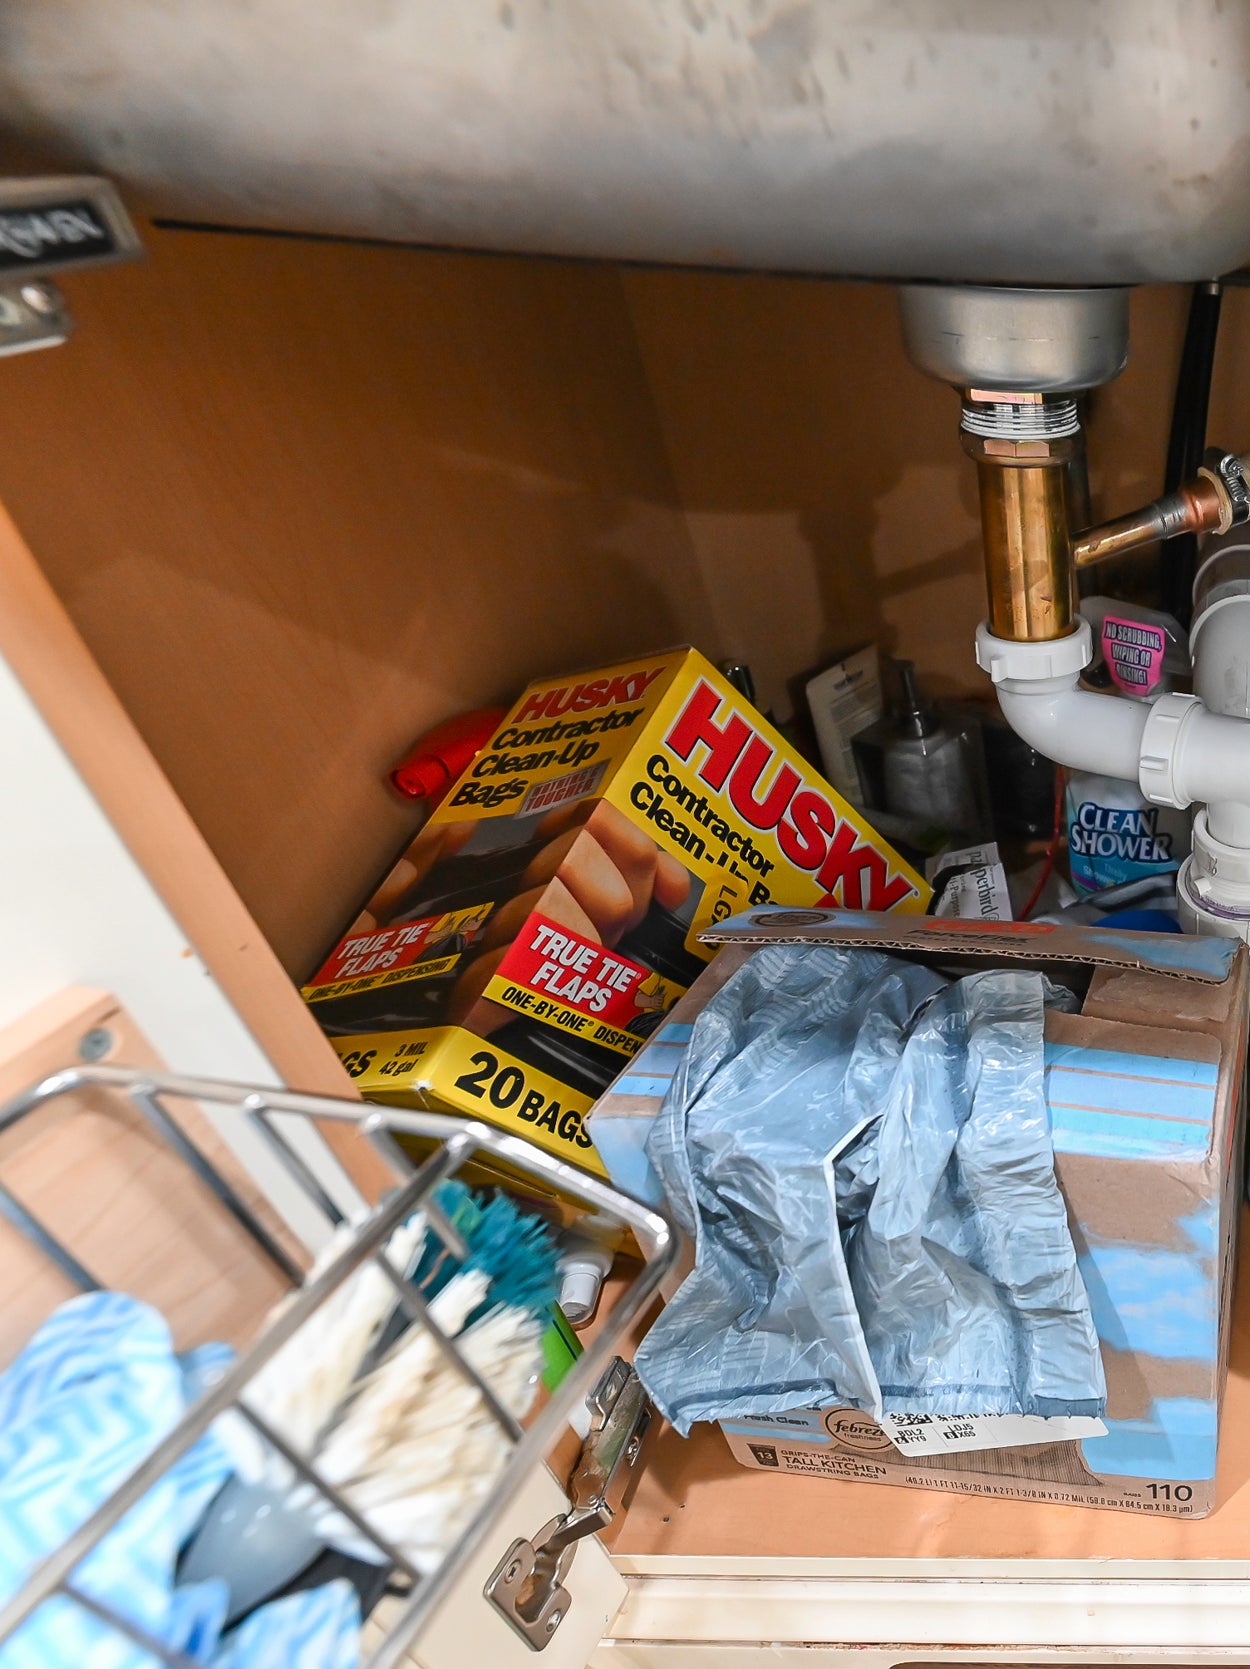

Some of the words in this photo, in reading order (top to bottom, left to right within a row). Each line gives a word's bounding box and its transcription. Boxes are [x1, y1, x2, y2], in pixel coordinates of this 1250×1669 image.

[1105, 622, 1118, 639] NO
[1117, 624, 1162, 652] SCRUBBING,
[1112, 643, 1140, 665] WIPING
[510, 666, 667, 725] HUSKY
[492, 708, 645, 750] Contractor
[472, 739, 600, 777] Clean-Up
[448, 778, 529, 808] Bags
[664, 679, 914, 911] HUSKY
[646, 754, 774, 878] Contractor
[1079, 804, 1158, 836] CLEAN
[1071, 825, 1171, 861] SHOWER
[337, 930, 395, 959] TRUE
[394, 922, 430, 946] TIE
[335, 947, 403, 979] FLAPS
[382, 958, 451, 984] DISPENSING
[530, 924, 599, 973] TRUE
[595, 957, 637, 992] TIE
[530, 961, 612, 1012] FLAPS
[395, 1044, 404, 1057] 3
[404, 1042, 429, 1057] MIL
[379, 1061, 398, 1076] 42
[392, 1059, 418, 1077] gal
[454, 1051, 525, 1109] 20
[776, 1416, 809, 1426] Clean
[844, 1432, 882, 1442] freshness
[757, 1452, 774, 1460] 13
[782, 1456, 818, 1467] TALL
[822, 1459, 887, 1475] KITCHEN
[780, 1450, 856, 1463] GRIPS-THE-CAN
[786, 1464, 851, 1476] DRAWSTRING
[940, 1480, 949, 1489] FT
[951, 1482, 982, 1493] 11-15/32
[984, 1485, 992, 1494] IN
[994, 1486, 998, 1494] X
[1000, 1487, 1005, 1495] 2
[1006, 1488, 1014, 1496] FT
[1048, 1492, 1053, 1500] X
[1054, 1492, 1069, 1501] 0.72
[1072, 1494, 1084, 1503] MIL
[1107, 1499, 1118, 1507] cm
[1162, 1504, 1177, 1513] 18.3
[1146, 1483, 1193, 1502] 110
